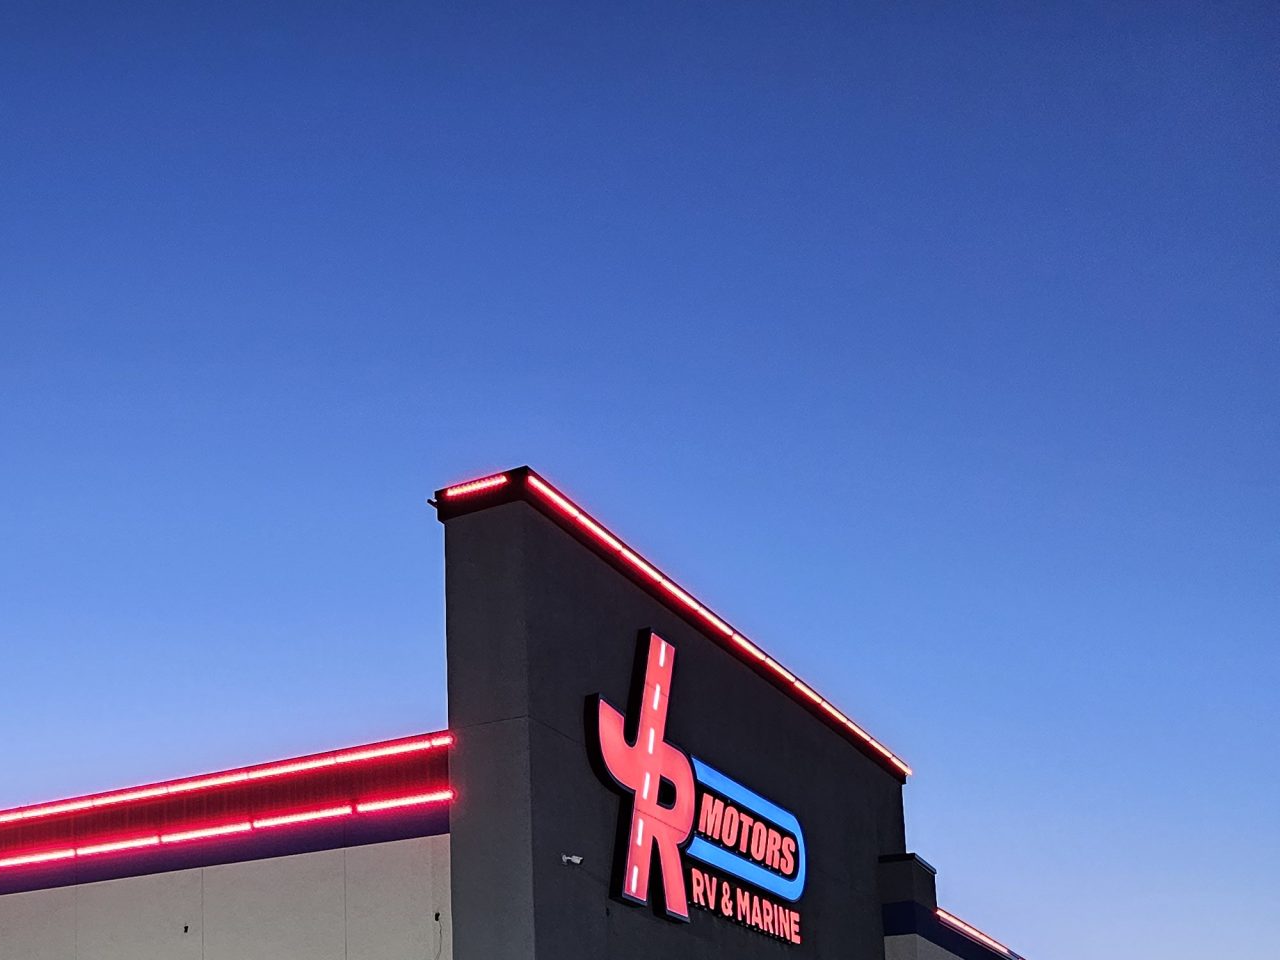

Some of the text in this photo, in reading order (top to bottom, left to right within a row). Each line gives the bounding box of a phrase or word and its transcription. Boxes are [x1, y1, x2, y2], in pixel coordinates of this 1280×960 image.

[698, 793, 796, 875] MOTORS
[691, 867, 801, 944] RV & MARINE
